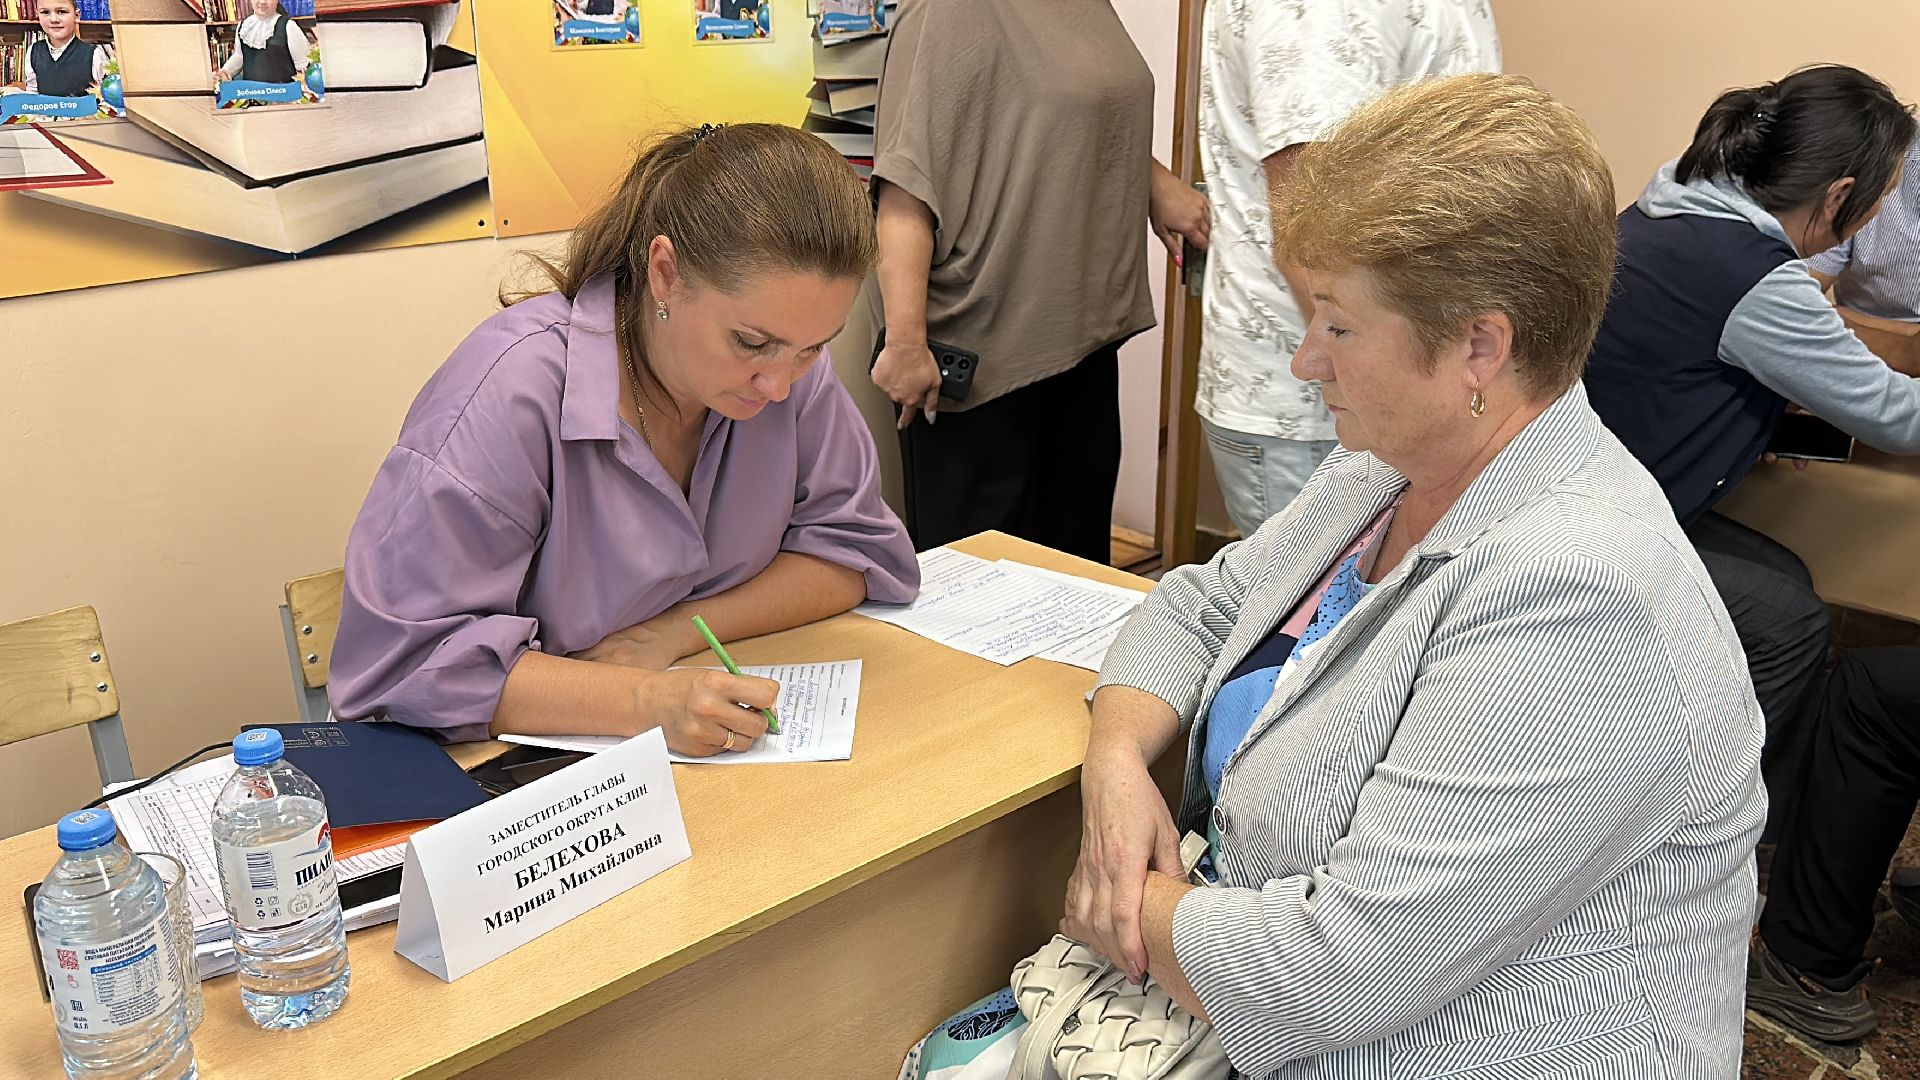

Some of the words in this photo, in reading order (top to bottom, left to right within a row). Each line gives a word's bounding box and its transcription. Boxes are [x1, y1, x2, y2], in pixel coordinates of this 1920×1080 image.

[21, 101, 58, 112] Федоров
[59, 100, 78, 110] Егор
[265, 87, 288, 97] Олеся
[477, 825, 564, 876] ГОРОДСКОГО
[566, 802, 614, 831] ОКРУГА
[615, 783, 649, 808] КЛИН
[488, 794, 582, 846] ЗАМЕСТИТЕЛЬ
[583, 772, 626, 801] ГЛАВЫ
[483, 887, 556, 934] Марина
[559, 833, 663, 895] Михайловна
[514, 822, 627, 890] БЕЛЕХОВА
